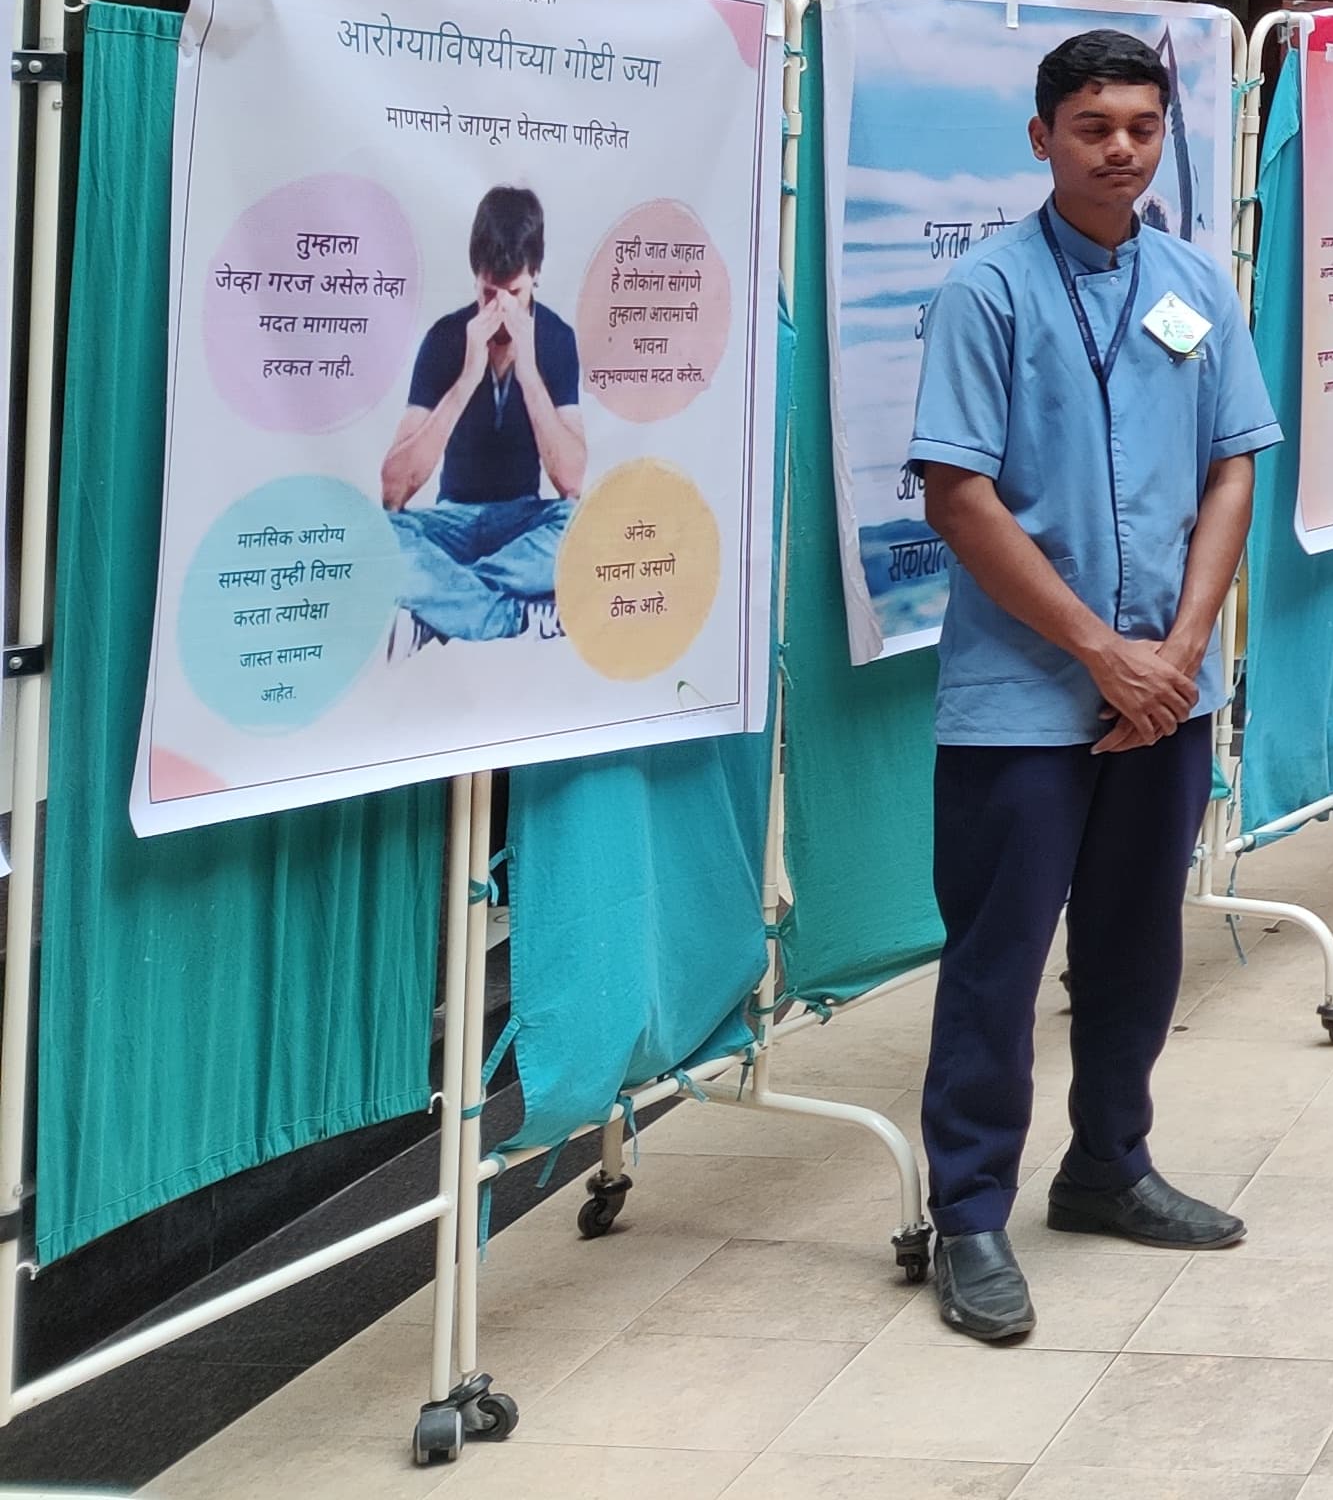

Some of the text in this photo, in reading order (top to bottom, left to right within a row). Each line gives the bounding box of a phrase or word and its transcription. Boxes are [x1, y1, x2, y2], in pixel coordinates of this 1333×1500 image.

[337, 13, 662, 88] आरोग्याविषयीच्या गोष्टी ज्या
[386, 105, 629, 150] माणसाने जाणून घेतल्या पाहिजेत
[296, 233, 360, 260] तुम्हाला
[615, 235, 706, 264] तुम्ही जात आहात
[215, 263, 406, 299] जेव्हा गरज असेल तेव्हा
[611, 267, 702, 293] हे लोकांना सांगणे
[259, 315, 368, 334] मदत मागायला
[609, 302, 699, 327] तुम्हाला आरामाची
[633, 338, 668, 354] भावना
[262, 355, 354, 378] हरकत नाही.
[589, 363, 705, 389] अनुभवण्यास मदत करेल.
[238, 523, 346, 548] मानसिक आरोग्य
[624, 520, 656, 540] अनेक
[218, 559, 353, 590] समस्या तुम्ही विचार
[595, 552, 676, 582] भावना असणे
[233, 598, 330, 627] करता त्यापेक्षा
[611, 591, 667, 617] ठीक आहे.
[240, 644, 323, 668] जास्त सामान्य
[261, 682, 296, 702] आहेत.
